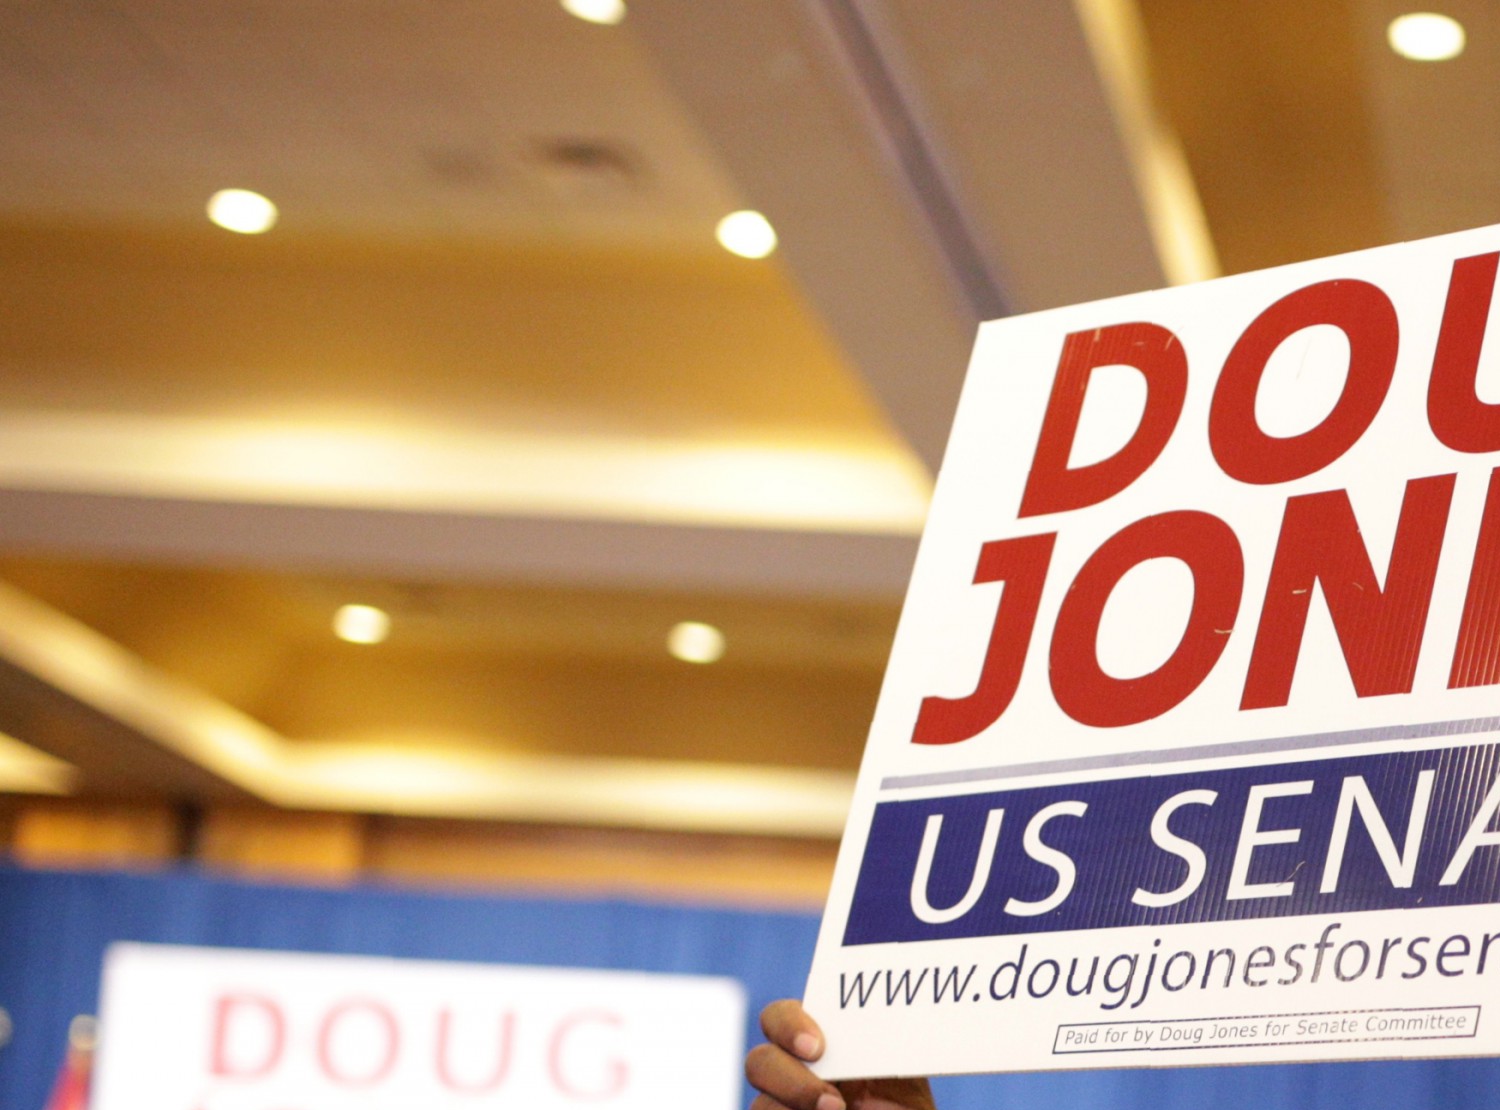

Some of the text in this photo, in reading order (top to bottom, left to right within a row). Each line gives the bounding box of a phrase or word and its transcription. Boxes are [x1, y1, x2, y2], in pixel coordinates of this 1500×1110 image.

[909, 800, 1087, 924] US
[208, 990, 634, 1102] DOUG
[1064, 1014, 1467, 1045] Paid for by Doug Jones for Senate Committee
